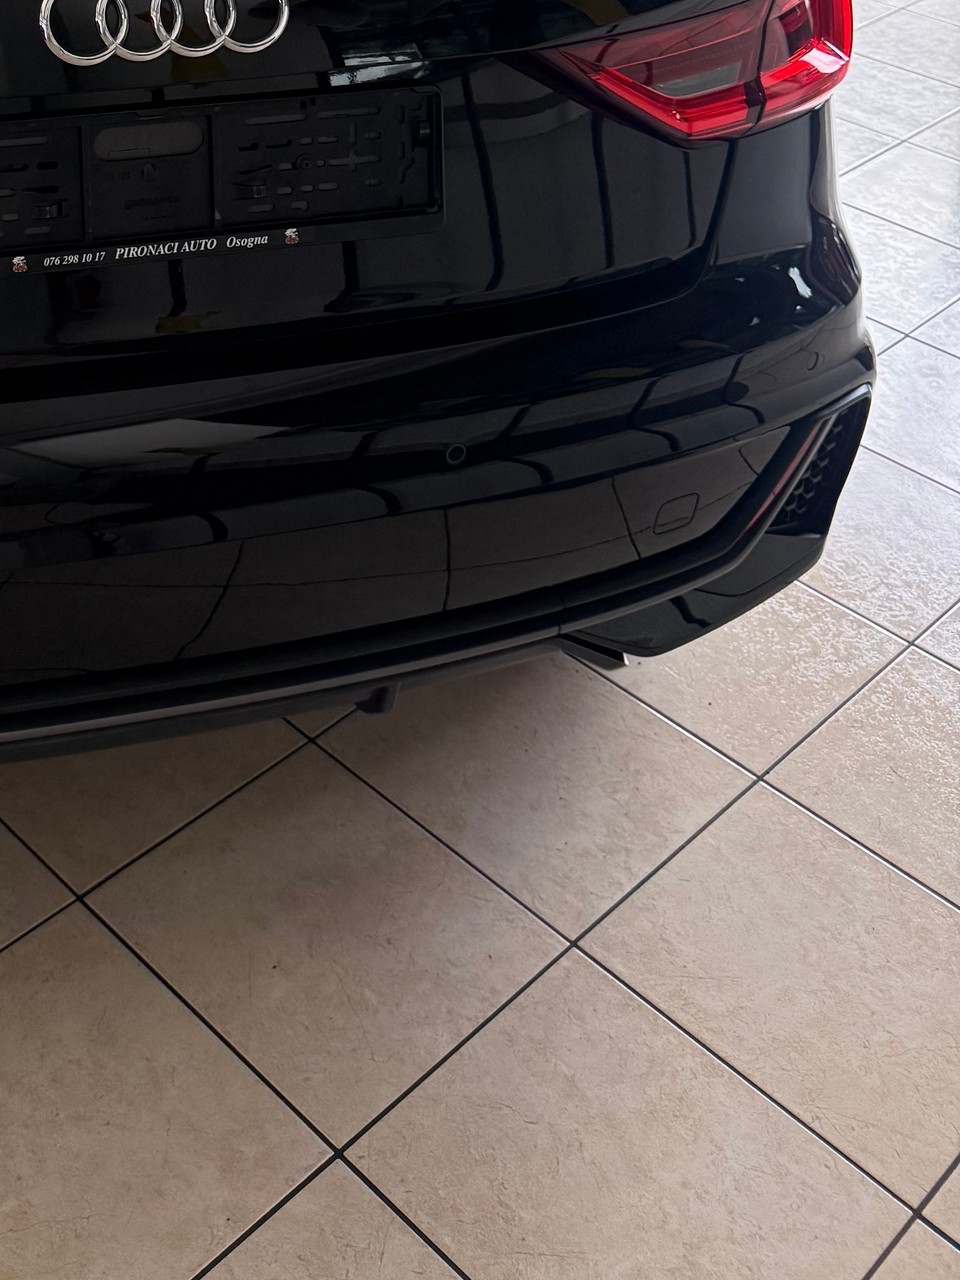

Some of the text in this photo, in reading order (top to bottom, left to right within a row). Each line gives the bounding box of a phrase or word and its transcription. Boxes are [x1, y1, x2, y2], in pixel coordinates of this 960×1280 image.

[43, 235, 269, 267] 076 298 10 17 PIRONACI AUTO Osogna
